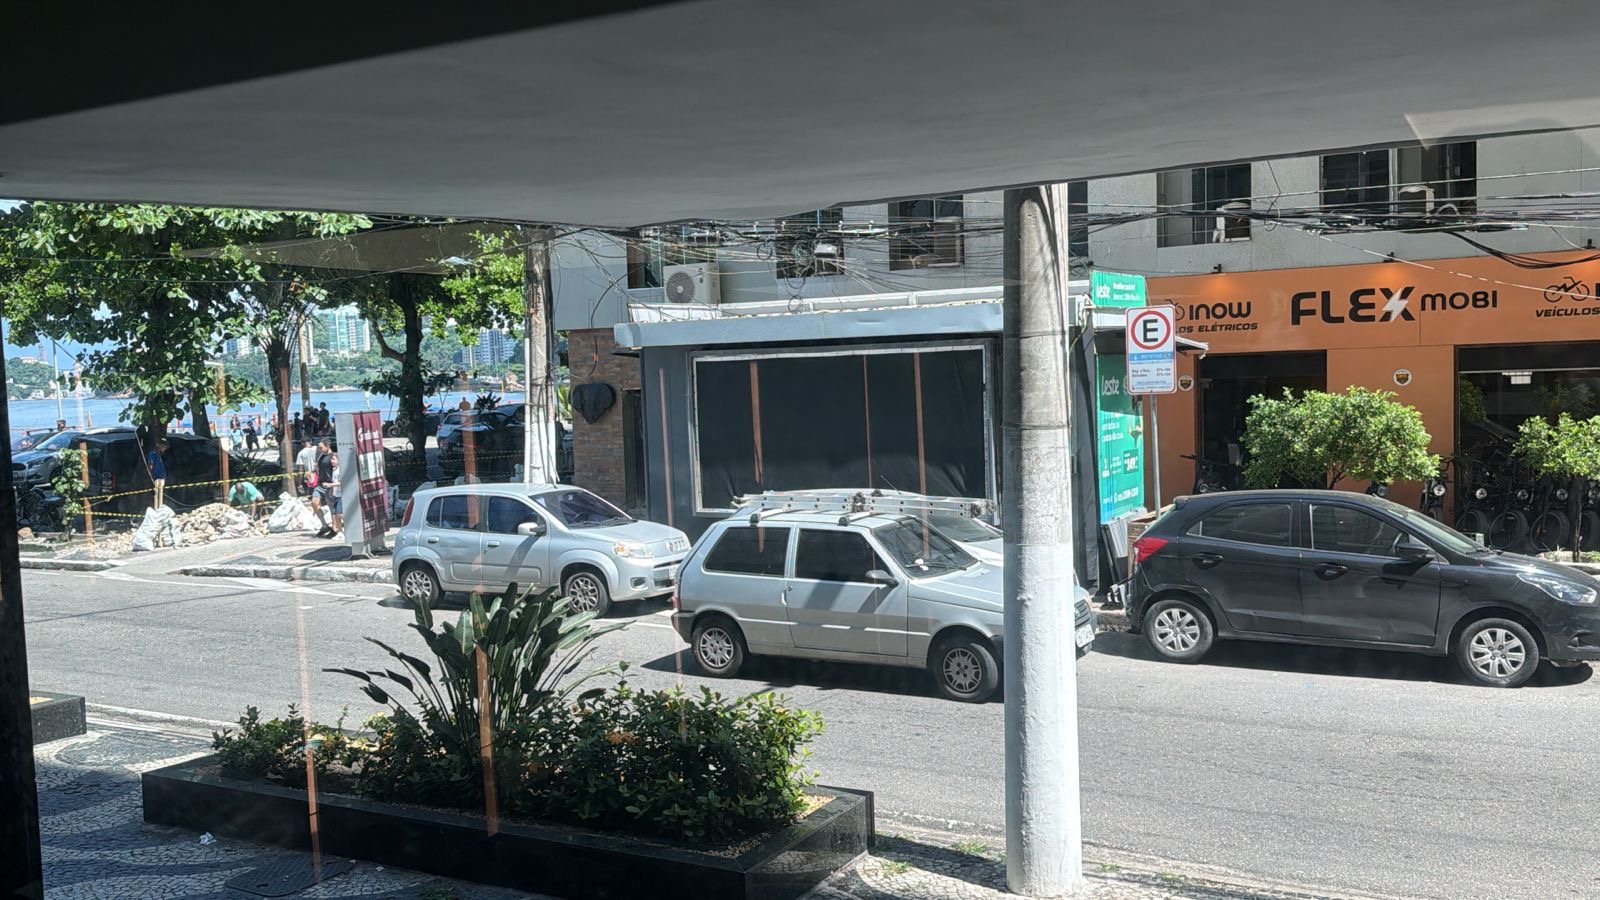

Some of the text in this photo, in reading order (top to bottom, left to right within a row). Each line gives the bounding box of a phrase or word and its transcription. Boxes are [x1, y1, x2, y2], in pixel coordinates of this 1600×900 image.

[1291, 286, 1415, 325] FLEX
[1143, 318, 1159, 343] E
[1198, 322, 1258, 332] ELÉTRICOS
